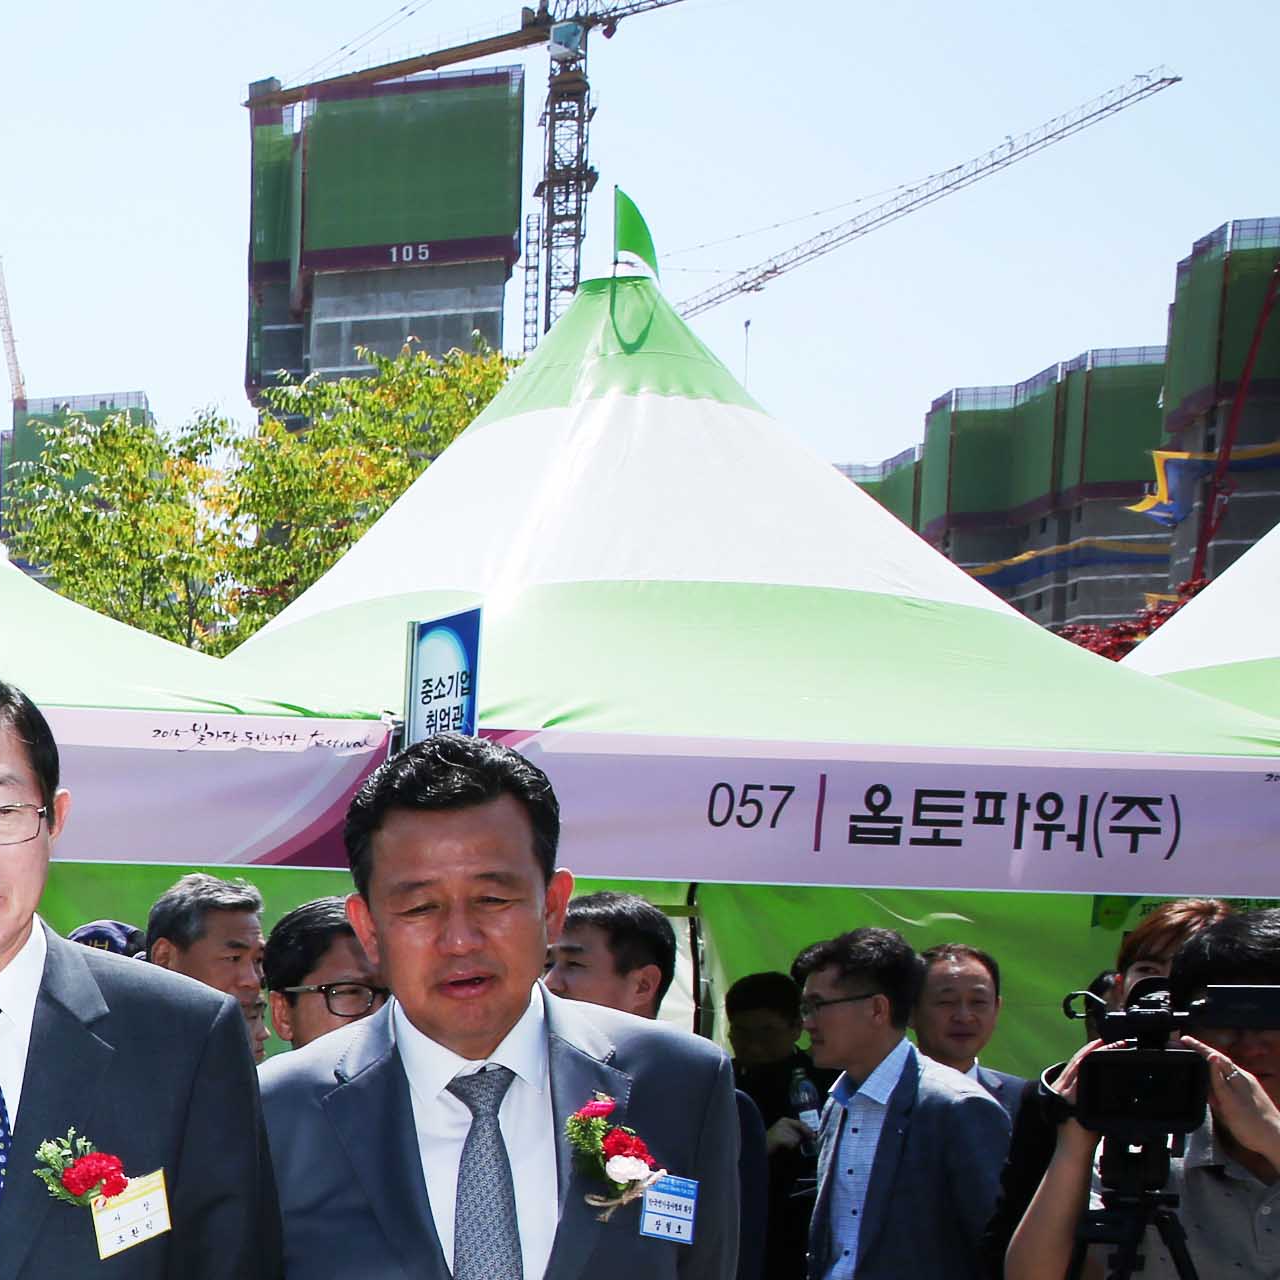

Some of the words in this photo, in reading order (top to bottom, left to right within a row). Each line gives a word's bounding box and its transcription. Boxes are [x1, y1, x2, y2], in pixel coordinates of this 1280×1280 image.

[389, 244, 430, 263] 105
[421, 670, 471, 705] 중소기업
[426, 704, 464, 735] 취업관
[706, 782, 795, 829] 057
[848, 783, 1181, 860] 옵토파워(주)
